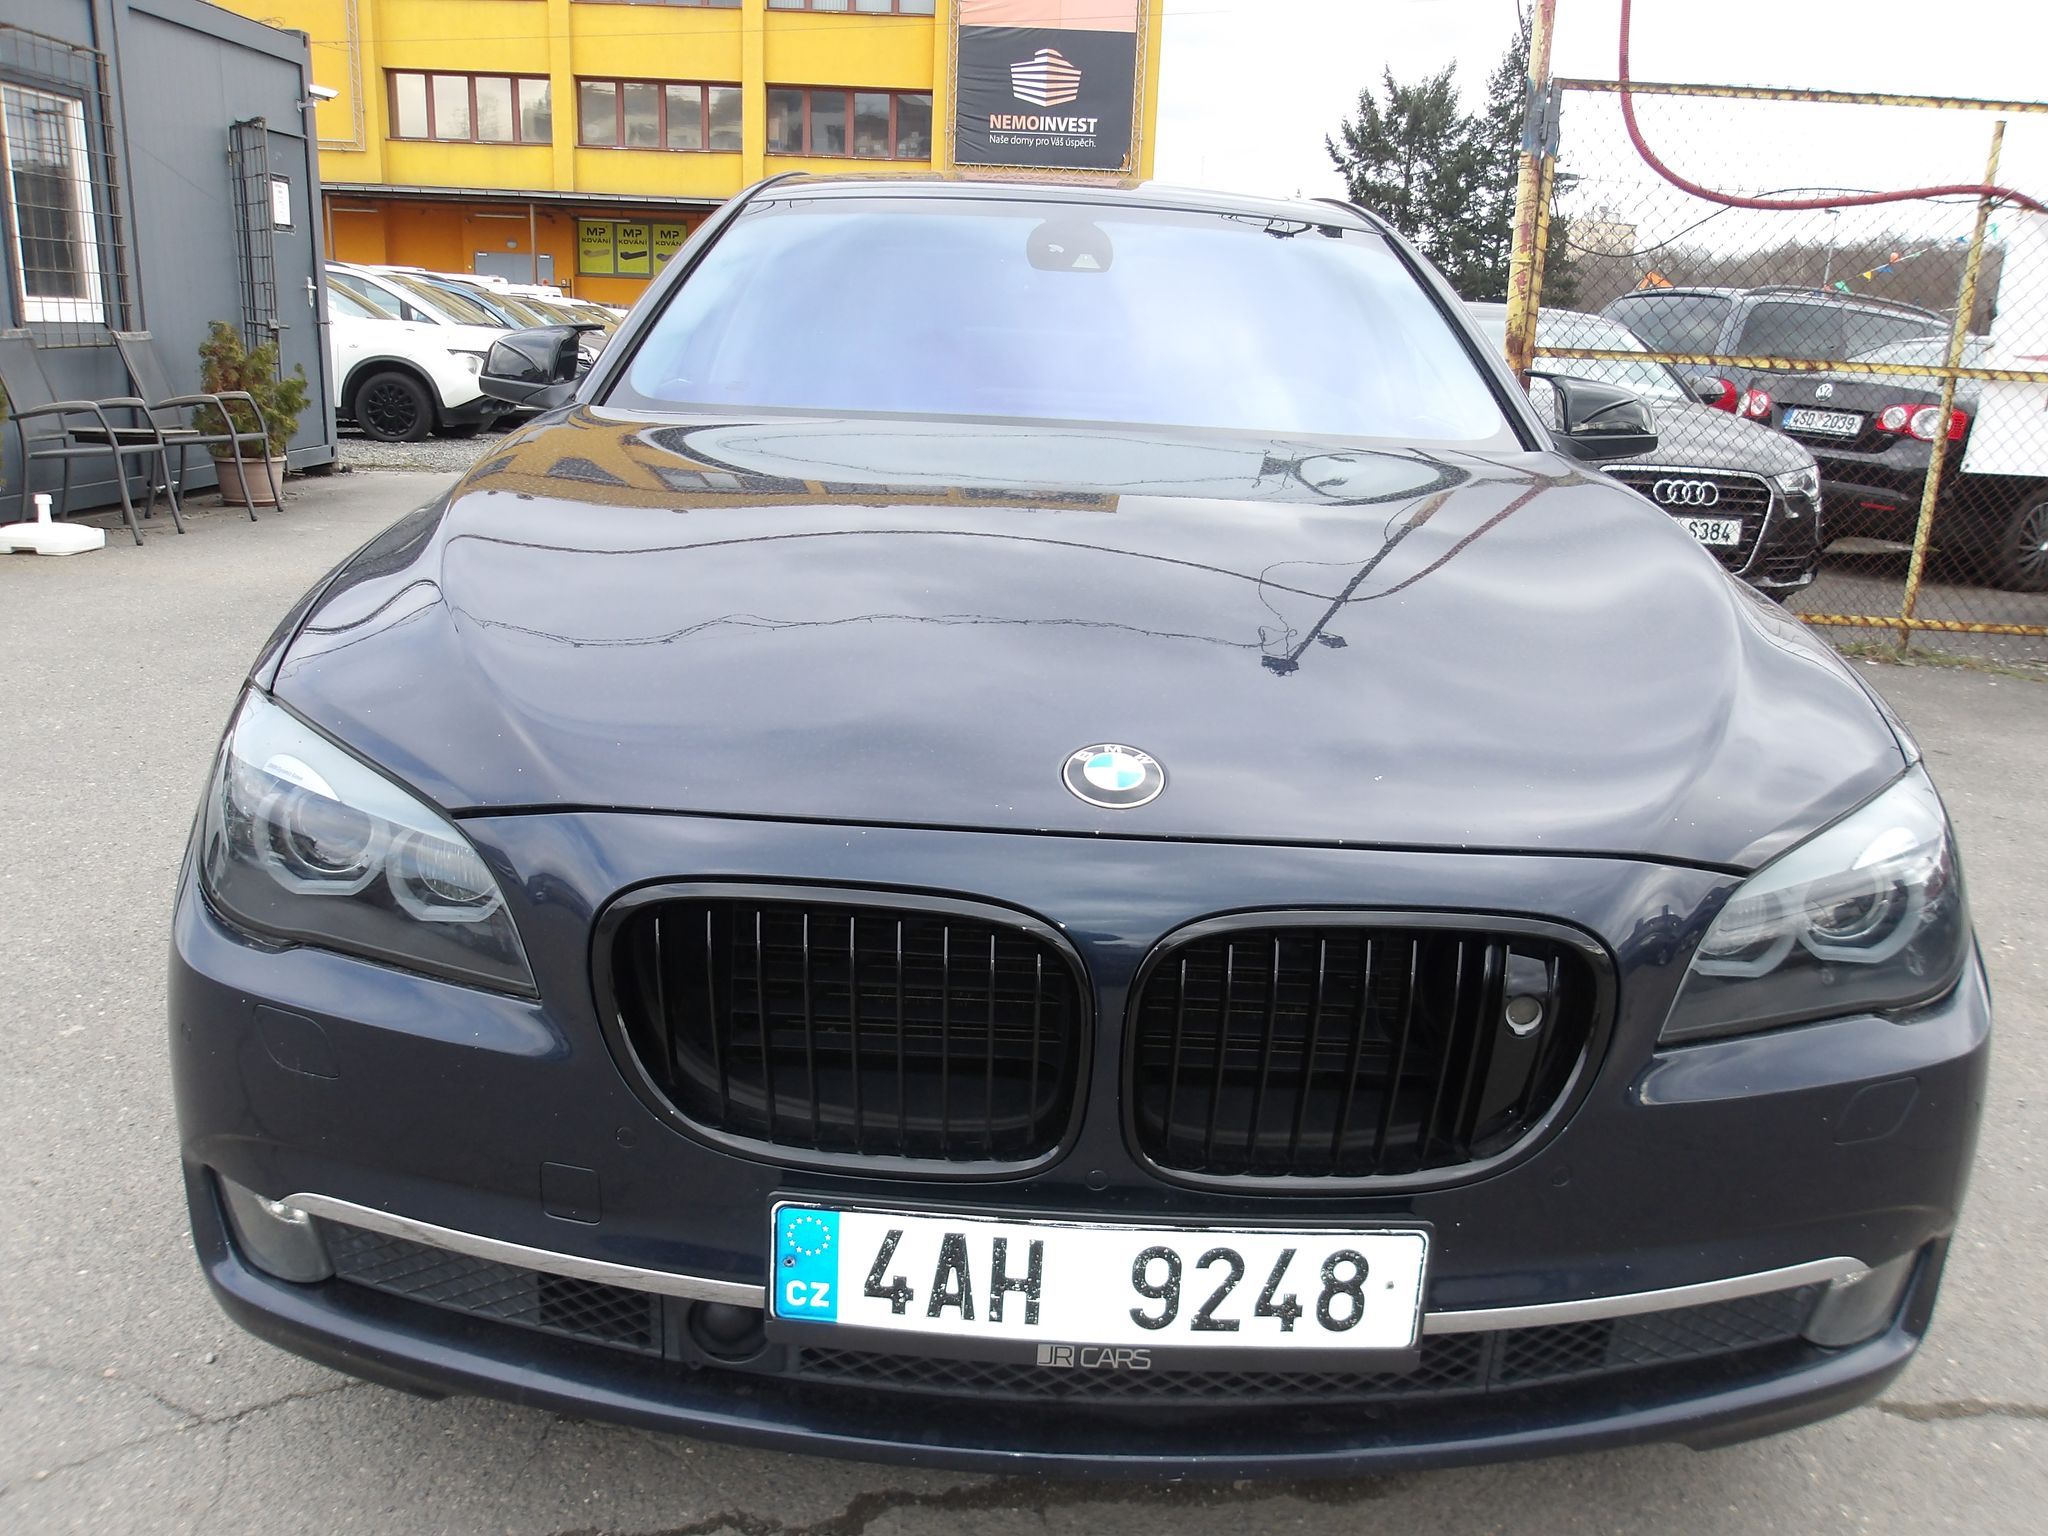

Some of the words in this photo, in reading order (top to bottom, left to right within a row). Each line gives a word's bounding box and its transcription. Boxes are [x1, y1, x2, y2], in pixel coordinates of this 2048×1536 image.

[989, 114, 1098, 133] NEMOINVEST
[989, 134, 1009, 145] Naše
[1010, 135, 1034, 147] domy
[1035, 138, 1050, 147] pro
[1050, 136, 1064, 147] Váš
[586, 227, 606, 236] MP
[623, 229, 643, 238] MP
[660, 230, 680, 239] MP
[1822, 414, 1856, 431] 2039
[863, 1229, 1045, 1326] 4AH
[1129, 1245, 1370, 1333] 9248
[786, 1279, 831, 1308] CZ
[1037, 1343, 1075, 1368] JR
[1080, 1347, 1152, 1370] CARS
